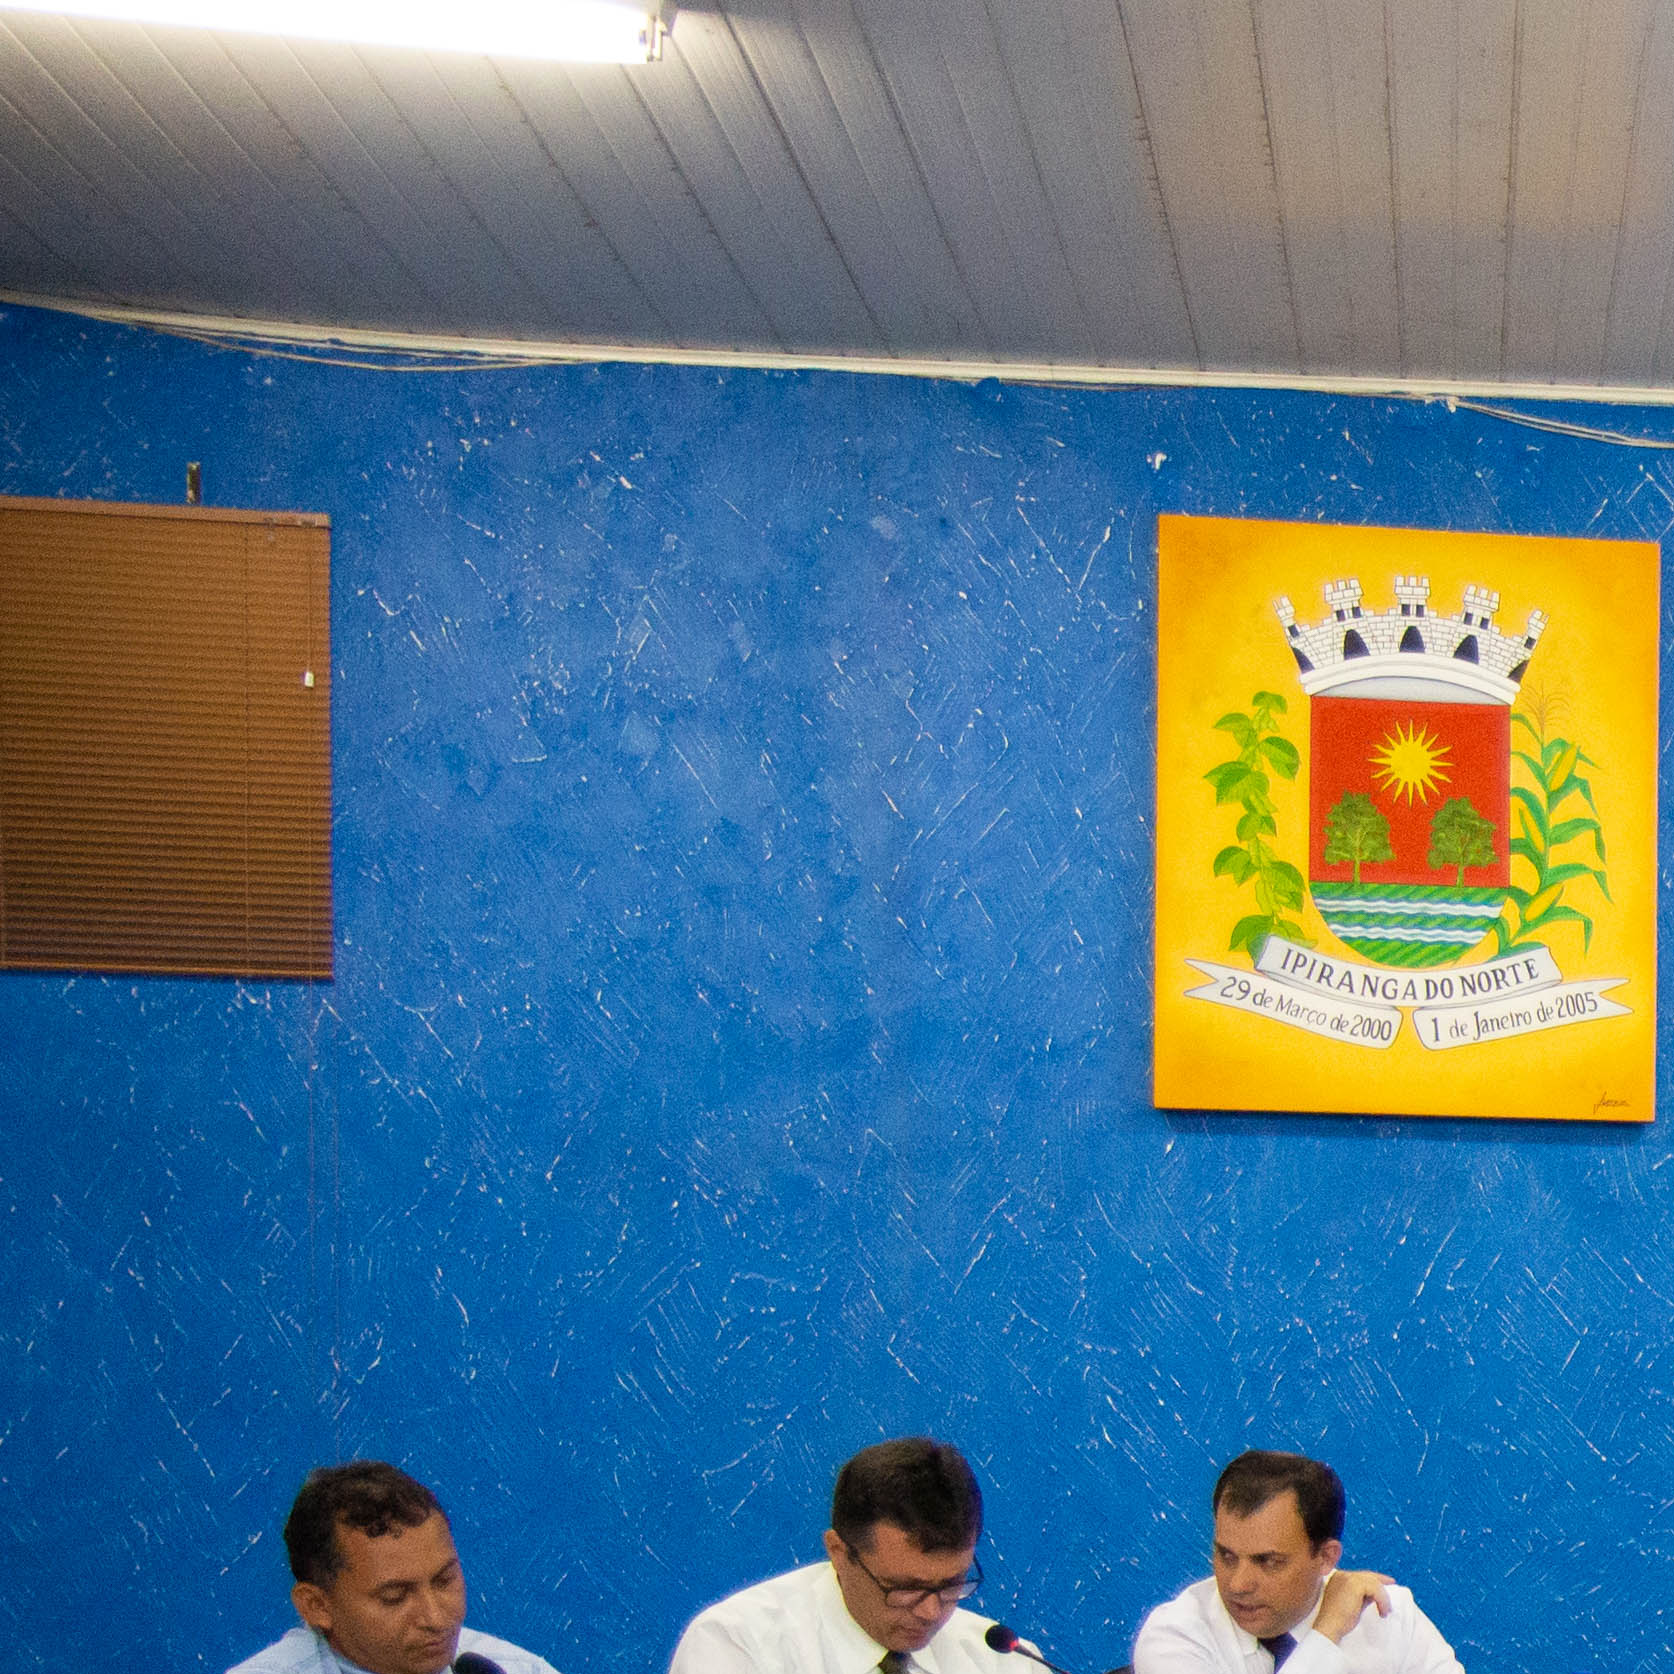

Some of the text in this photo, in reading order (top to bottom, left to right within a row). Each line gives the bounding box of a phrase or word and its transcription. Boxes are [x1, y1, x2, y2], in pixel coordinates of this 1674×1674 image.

[1280, 947, 1540, 1001] IPIRANGA DO NORTE
[1220, 976, 1392, 1042] 29 de Março de 2000
[1431, 990, 1598, 1043] 1 de Janeiro de 2005
